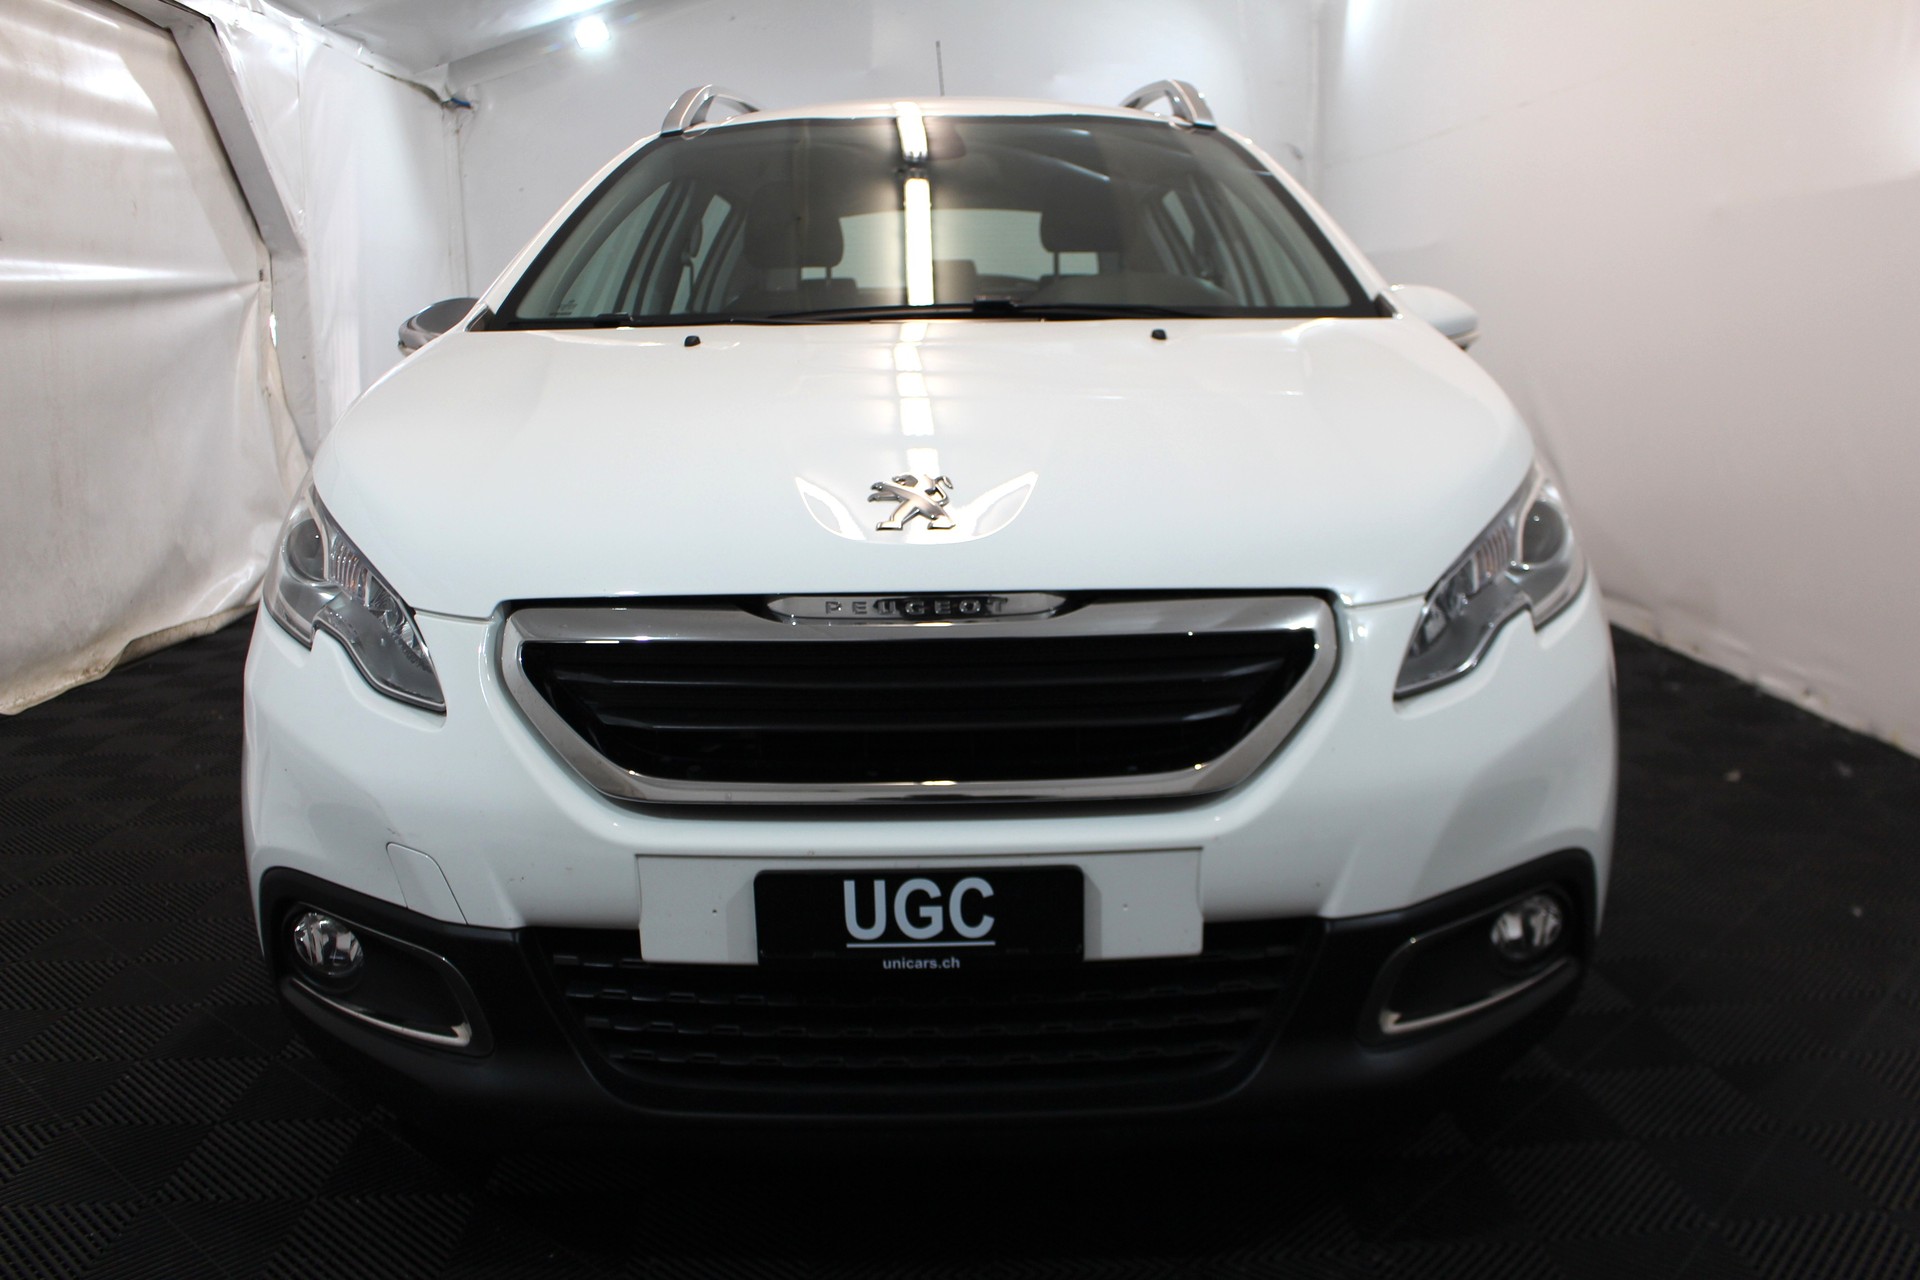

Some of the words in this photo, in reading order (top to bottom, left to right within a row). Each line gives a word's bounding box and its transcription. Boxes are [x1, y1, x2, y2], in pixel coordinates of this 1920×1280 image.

[825, 599, 1007, 616] PEUGEOT
[843, 876, 995, 940] UGC
[882, 956, 960, 970] unicars.ch
